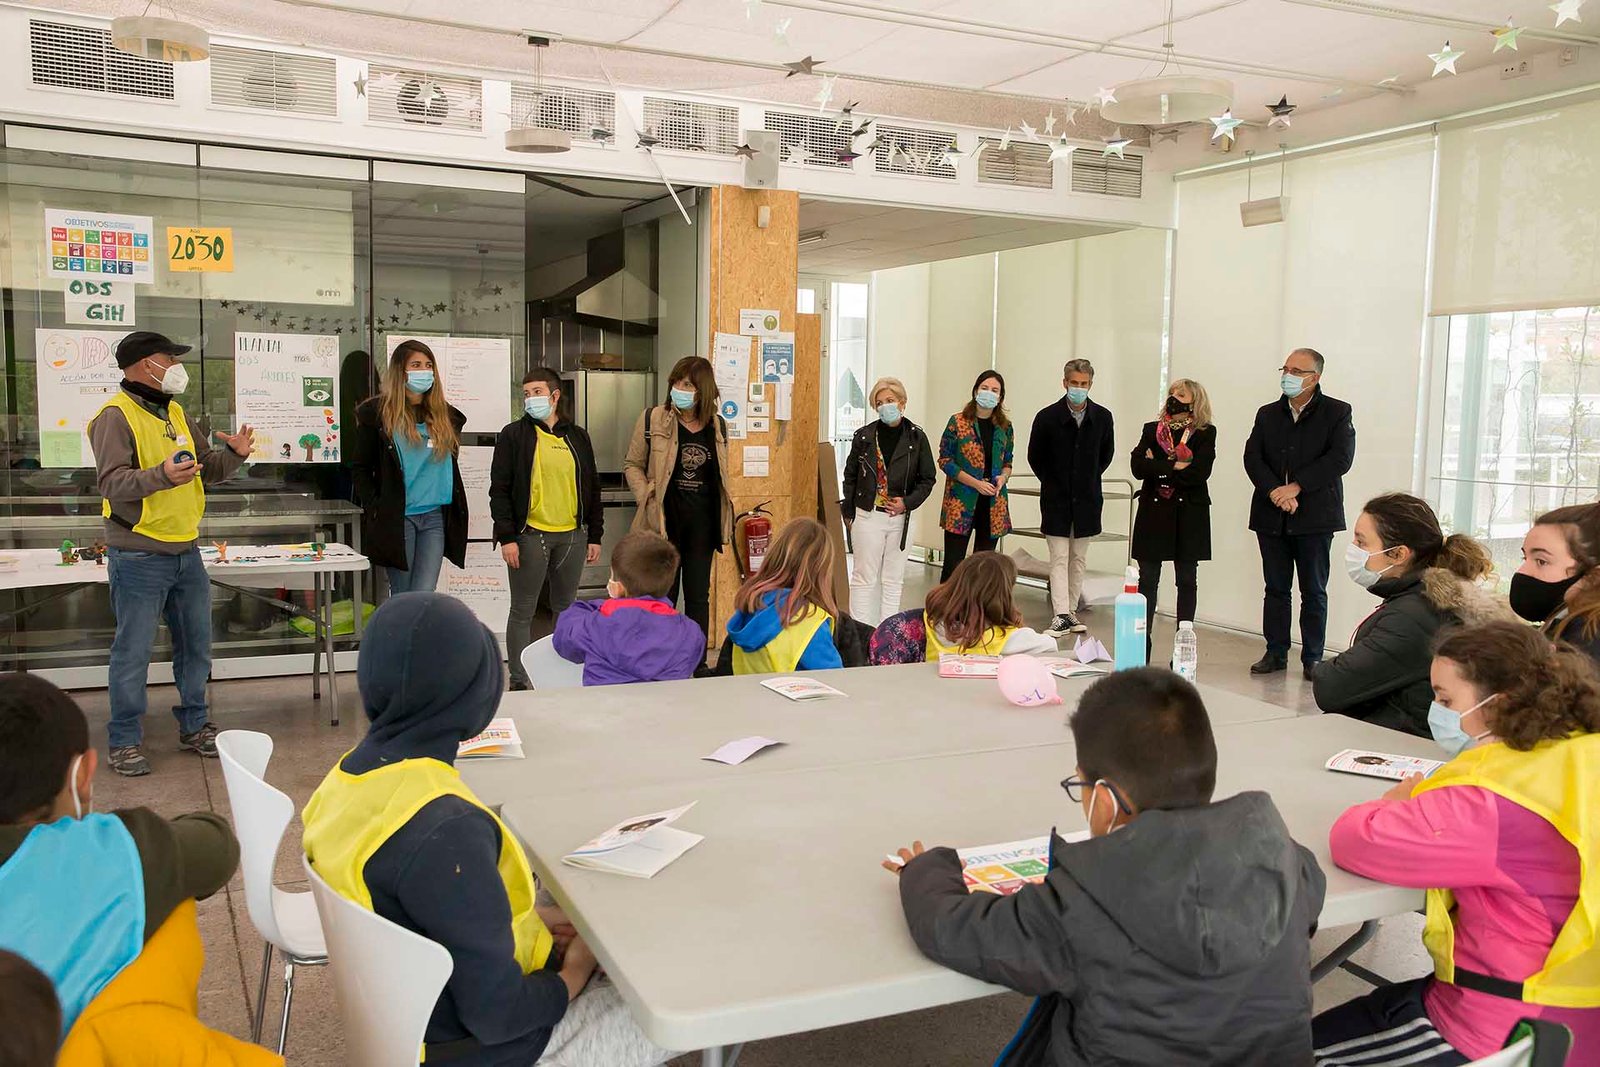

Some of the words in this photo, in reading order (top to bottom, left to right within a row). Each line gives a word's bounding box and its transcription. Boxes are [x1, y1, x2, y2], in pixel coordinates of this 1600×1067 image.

[64, 217, 109, 229] OBJETIVOS
[171, 234, 225, 262] 2030
[69, 279, 113, 297] ODS
